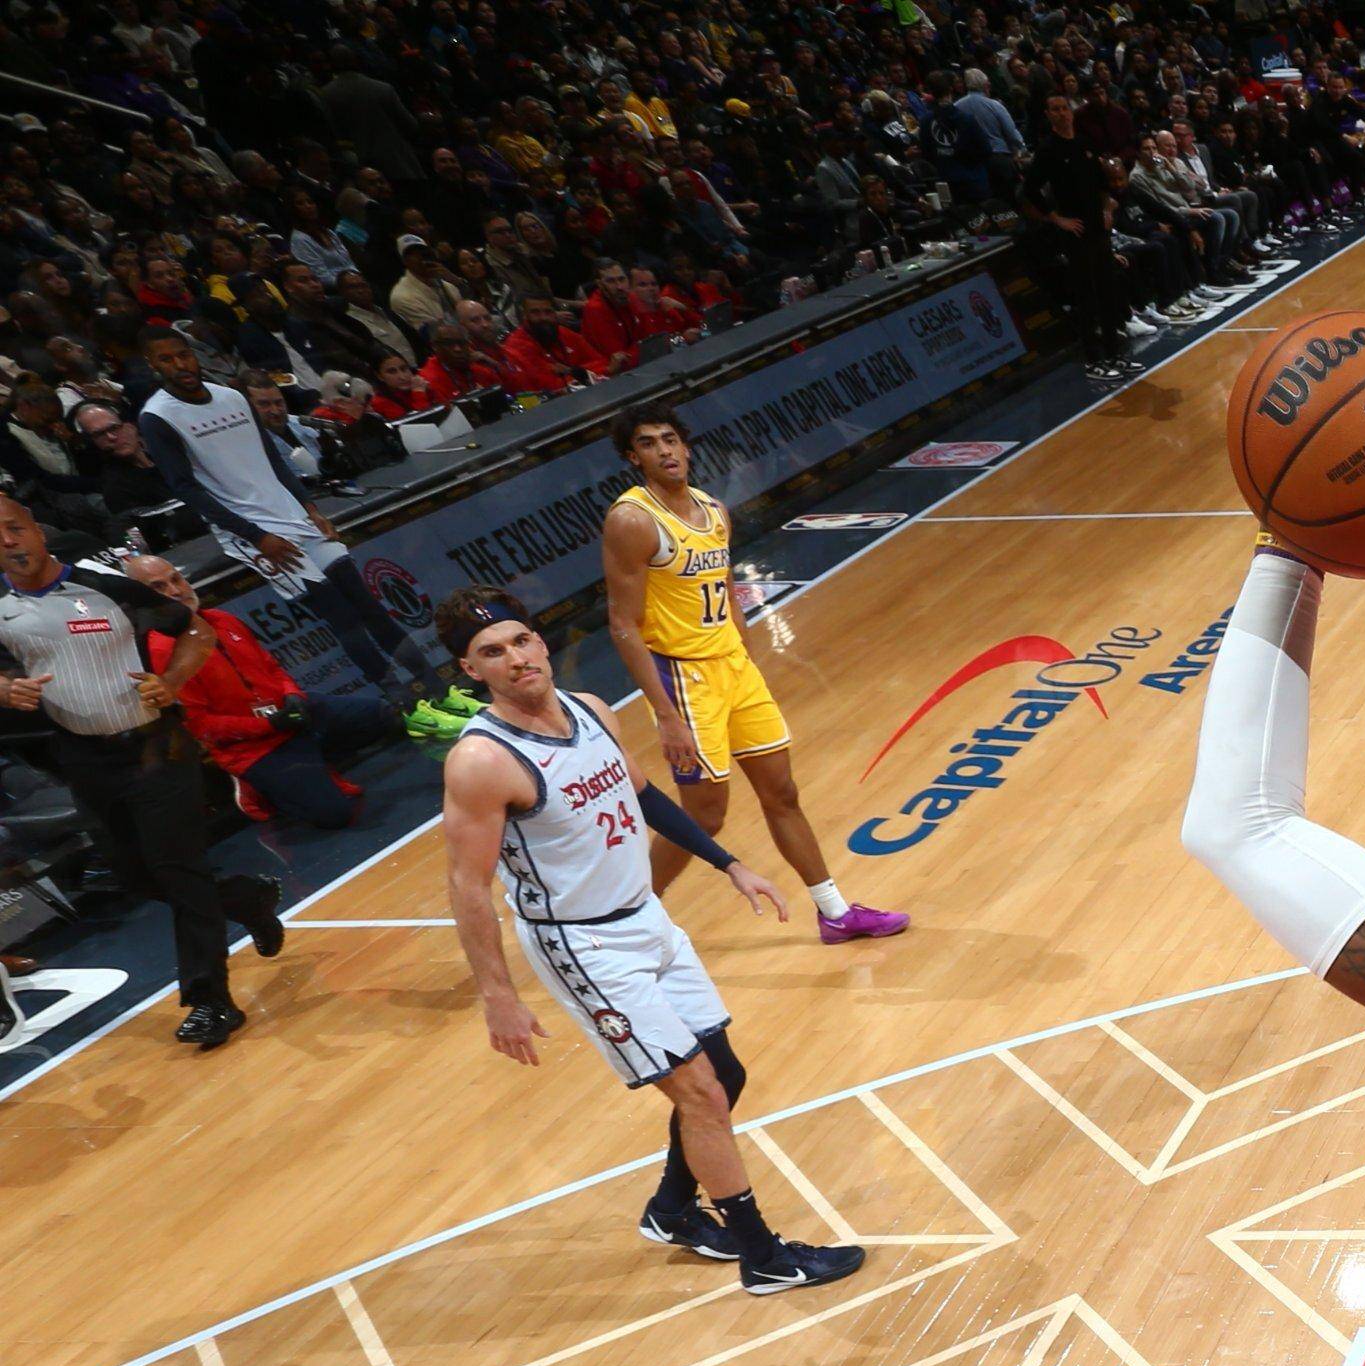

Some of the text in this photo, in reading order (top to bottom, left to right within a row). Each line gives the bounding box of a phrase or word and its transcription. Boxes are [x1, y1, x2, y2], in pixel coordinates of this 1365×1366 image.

[908, 299, 965, 339] CAESARS
[835, 362, 879, 408] ONE
[860, 345, 918, 396] ARENA
[763, 400, 800, 444] IN
[781, 377, 852, 434] CAPITAL
[733, 409, 778, 461] APP
[494, 486, 606, 577] EXCLUSIVE
[446, 537, 518, 587] THE
[677, 548, 731, 577] LAKER
[701, 580, 728, 627] 12
[559, 757, 627, 811] District
[596, 800, 638, 850] 24
